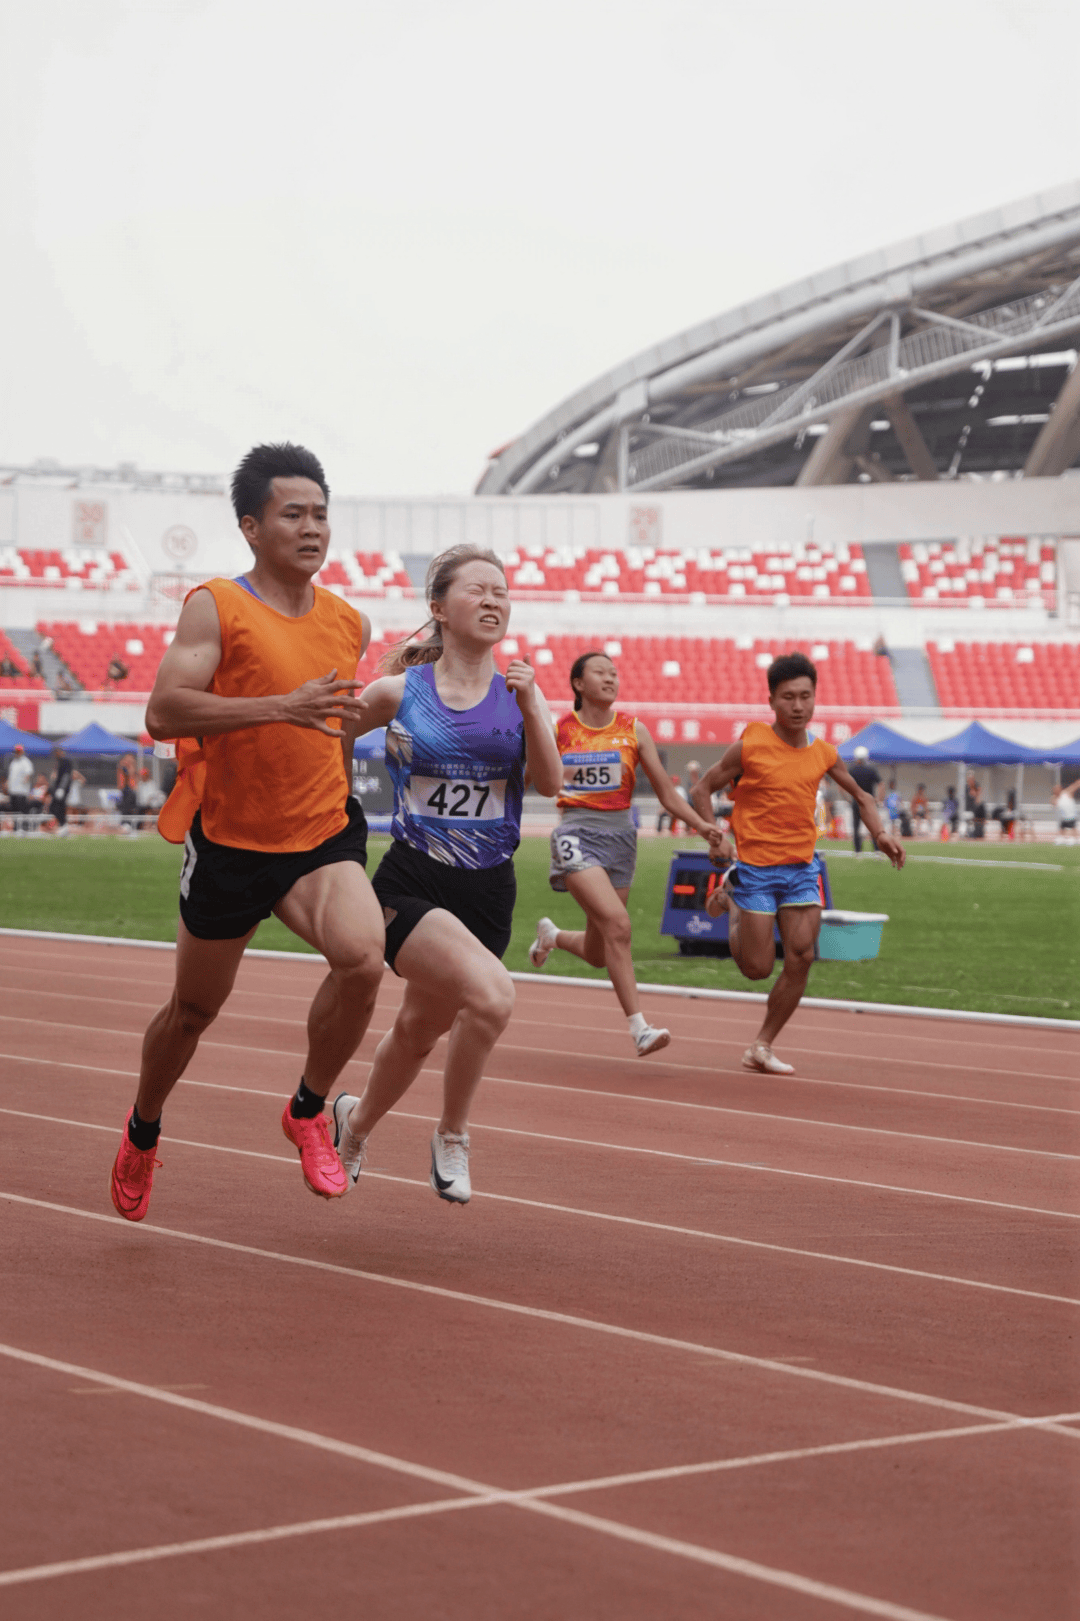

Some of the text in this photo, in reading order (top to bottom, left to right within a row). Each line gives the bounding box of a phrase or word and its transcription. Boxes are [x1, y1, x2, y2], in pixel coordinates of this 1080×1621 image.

[573, 766, 610, 785] 455
[427, 783, 490, 817] 427
[560, 840, 574, 861] 3
